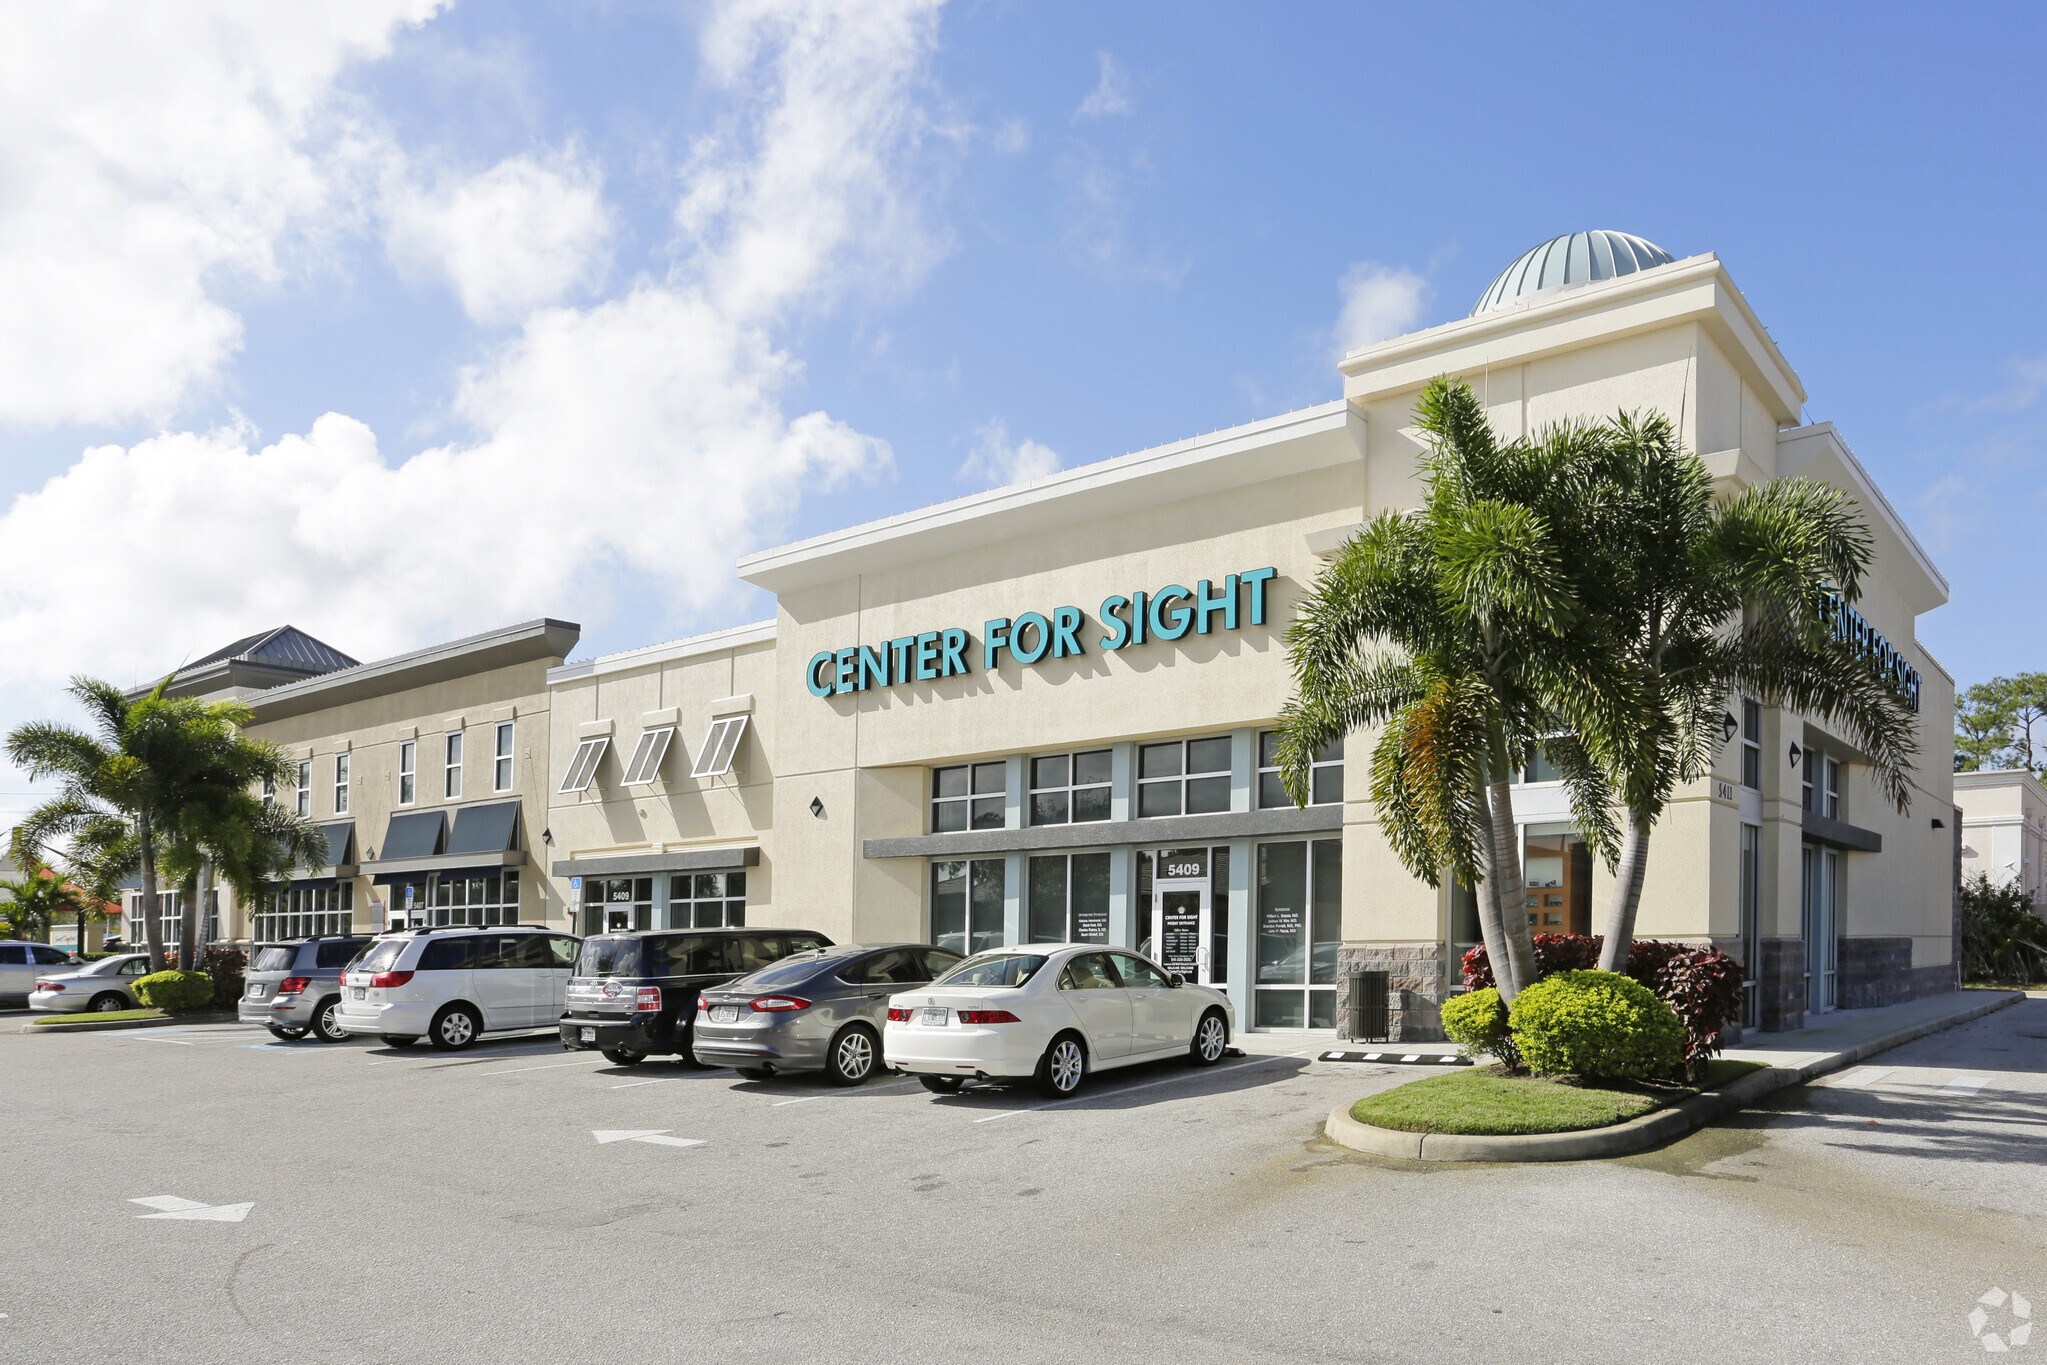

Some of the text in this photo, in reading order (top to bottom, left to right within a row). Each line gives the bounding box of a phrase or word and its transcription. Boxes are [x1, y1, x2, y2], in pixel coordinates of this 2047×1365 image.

[806, 567, 1277, 698] CENTER FOR SIGHT
[1895, 652, 1922, 712] SIGHT
[1718, 783, 1733, 800] 5411
[1168, 863, 1200, 877] 5409
[612, 892, 630, 900] 5409
